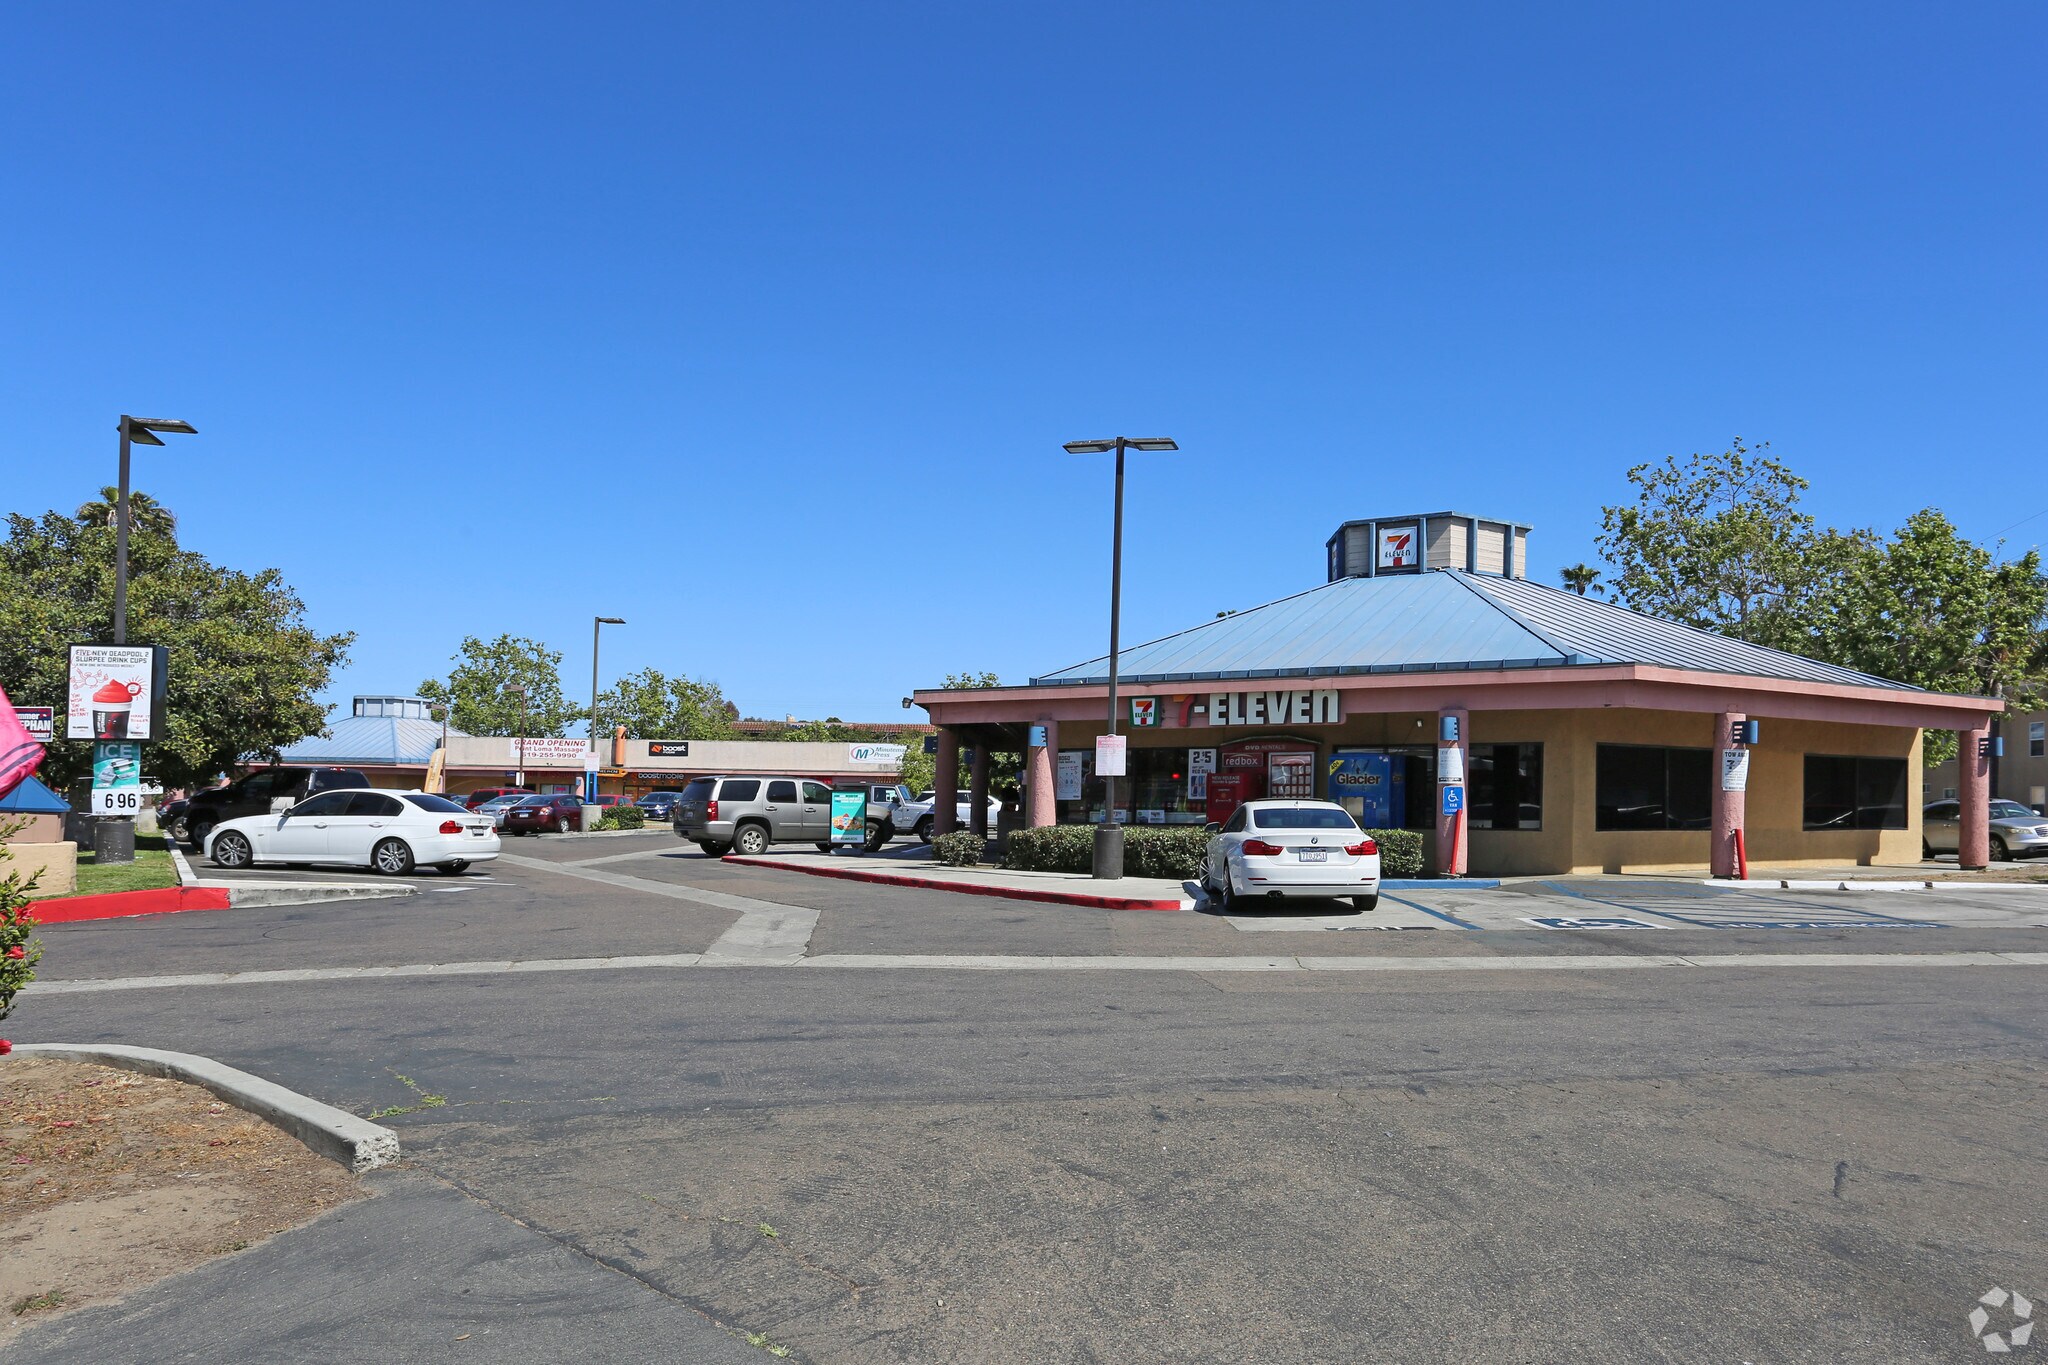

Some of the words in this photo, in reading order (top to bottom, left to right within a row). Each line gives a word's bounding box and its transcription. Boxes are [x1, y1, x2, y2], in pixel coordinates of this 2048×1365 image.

[1387, 533, 1410, 566] 7
[1136, 700, 1152, 725] 7
[100, 744, 132, 758] ICE
[1193, 751, 1200, 763] 2
[1225, 757, 1258, 765] redbox
[1336, 773, 1381, 785] Glacier
